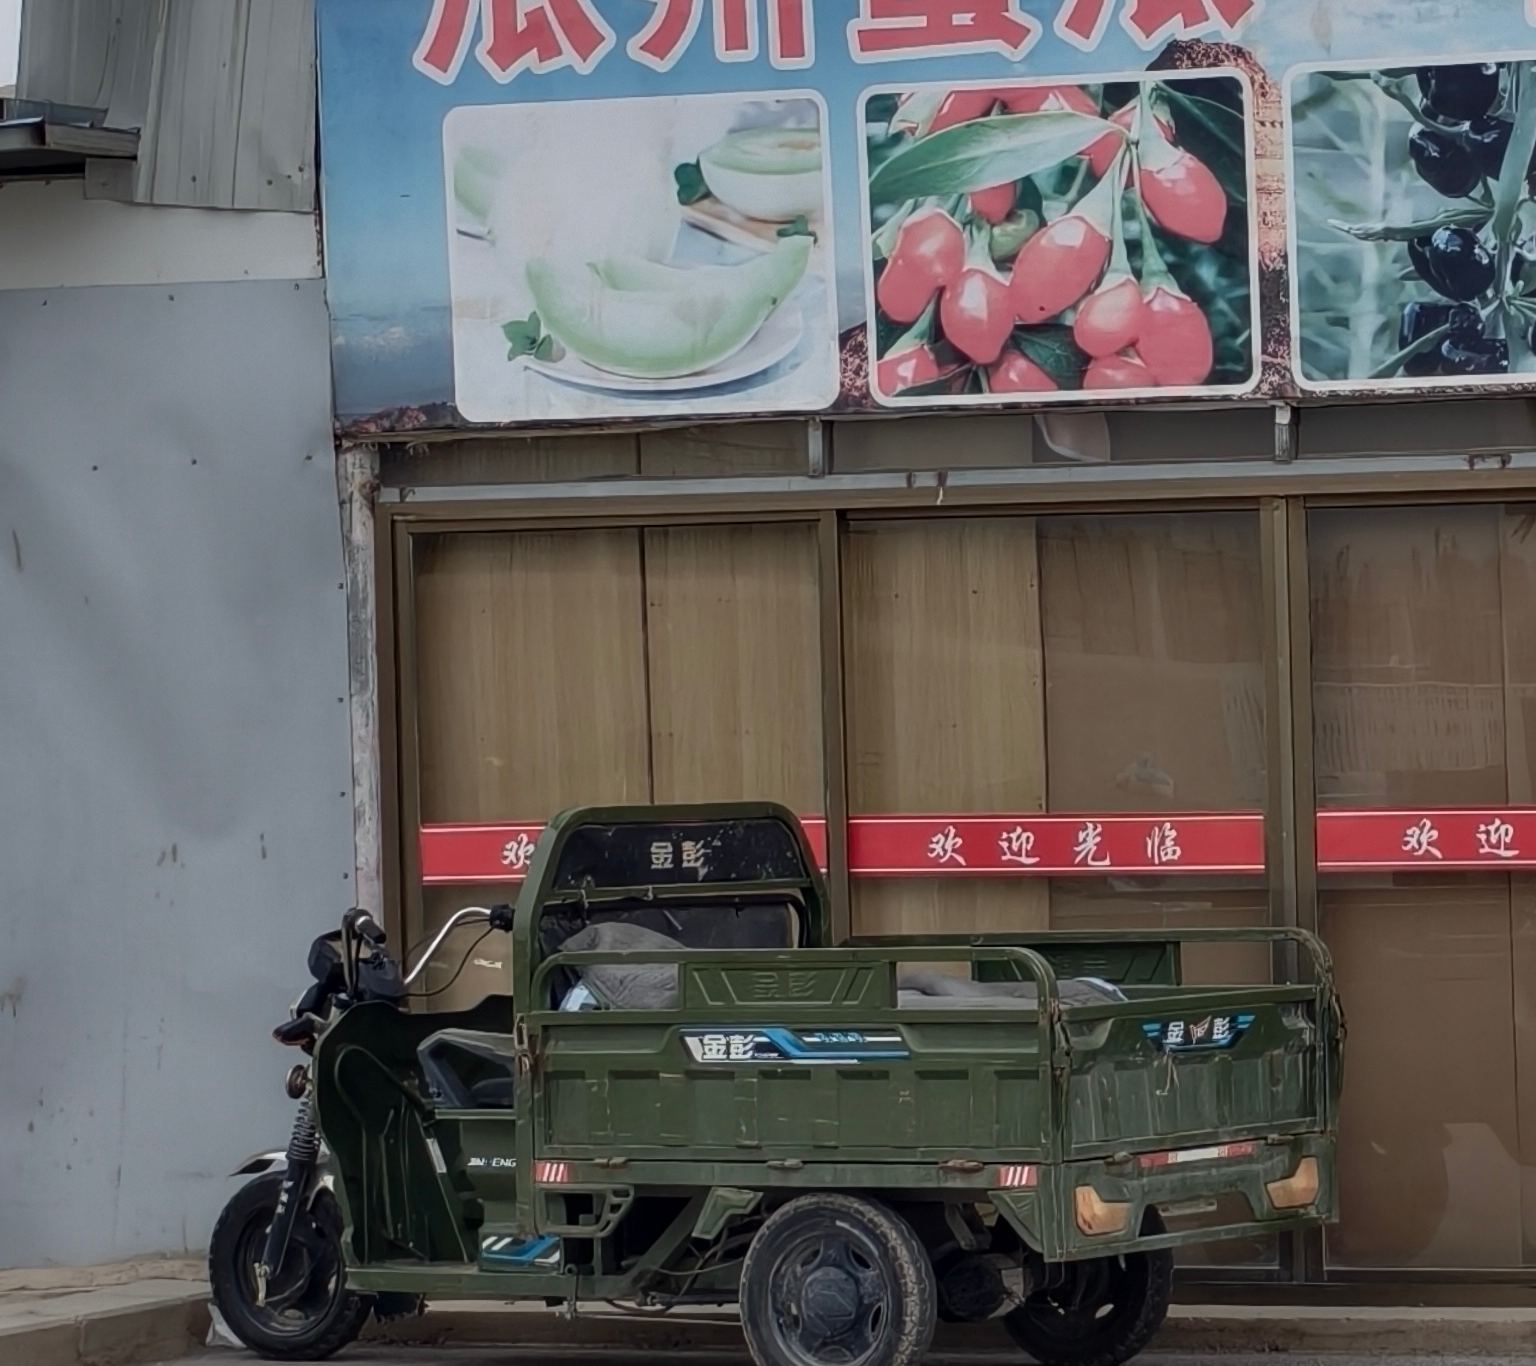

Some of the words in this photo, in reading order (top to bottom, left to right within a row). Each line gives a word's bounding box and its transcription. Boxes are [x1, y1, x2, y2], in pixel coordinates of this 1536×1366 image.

[927, 821, 1182, 866] 欢迎光临
[702, 1033, 756, 1061] 金彭
